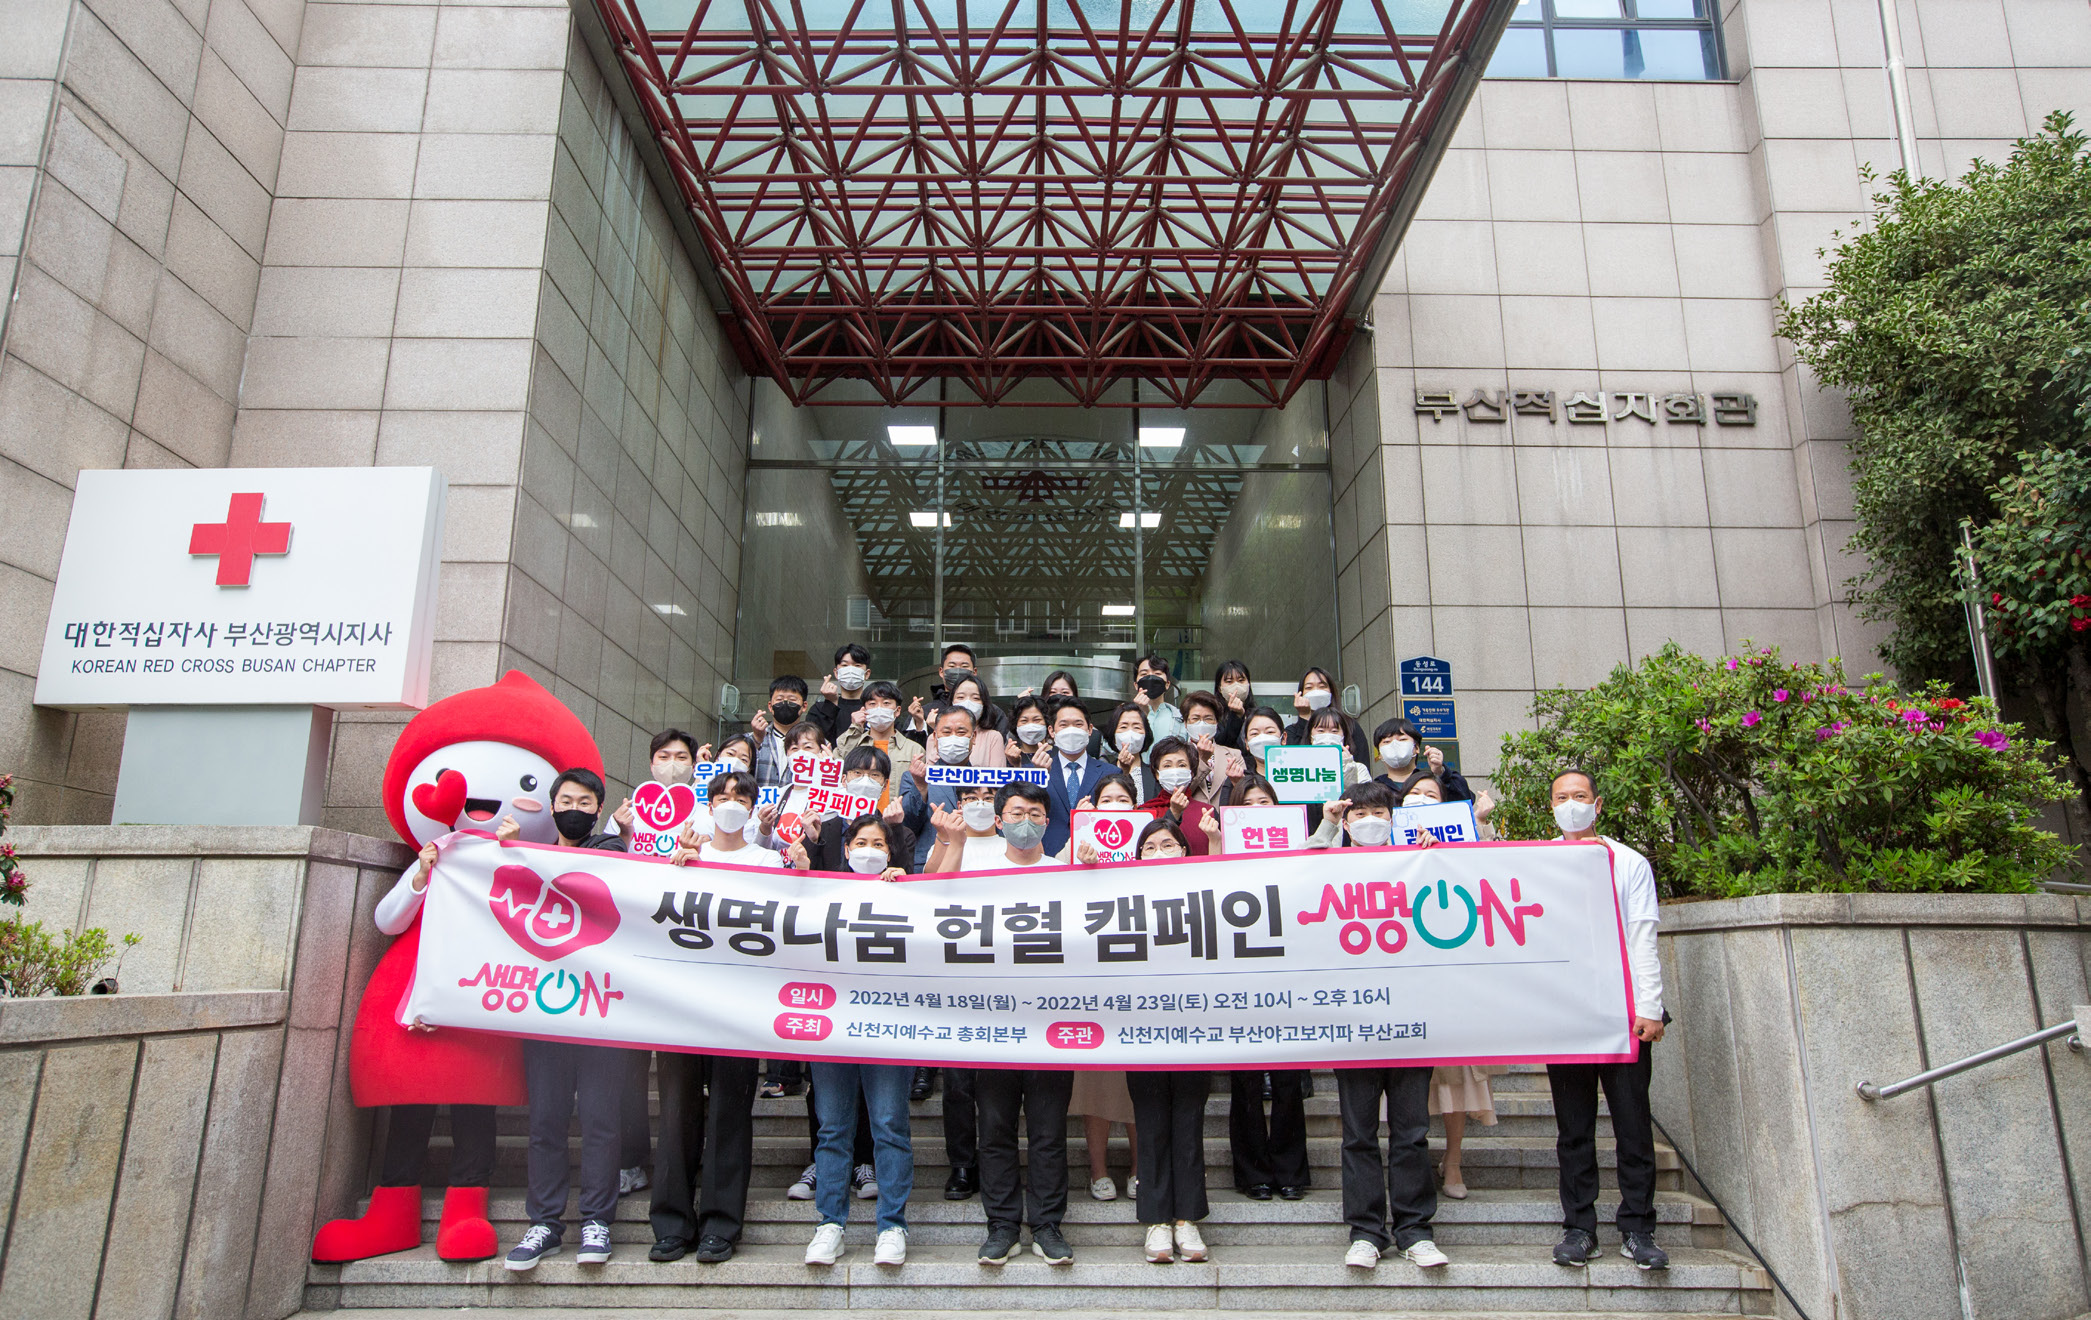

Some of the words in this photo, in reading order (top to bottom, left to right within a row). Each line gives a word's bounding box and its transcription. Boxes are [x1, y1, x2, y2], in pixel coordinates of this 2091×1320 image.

[64, 621, 217, 648] 대한적십자사
[224, 621, 392, 647] 부산광역시지사
[71, 659, 137, 673] KOREAN
[143, 659, 174, 673] RED
[181, 659, 235, 674] CROSS
[242, 659, 296, 673] BUSAN
[302, 658, 377, 673] CHAPTER
[1411, 676, 1444, 692] 144
[793, 756, 842, 788] 헌혈
[927, 767, 1047, 786] 부산야고보지파
[1272, 767, 1337, 783] 생명나눔
[808, 787, 876, 818] 캠페인
[1241, 827, 1290, 849] 헌혈
[651, 891, 914, 963] 생명나눔
[934, 901, 1065, 964] 헌혈
[1084, 884, 1285, 963] 캠페인
[789, 987, 825, 1007] 일시
[849, 988, 911, 1007] 2022년
[914, 991, 943, 1009] 4월
[947, 993, 1017, 1012] 18일(월)
[1036, 993, 1099, 1012] 2022년
[1103, 993, 1133, 1012] 4월
[1136, 993, 1209, 1013] 23일(토)
[1212, 991, 1249, 1010] 오전
[1253, 990, 1293, 1009] 10시
[1312, 988, 1348, 1007] 오후
[1352, 986, 1391, 1006] 16시
[785, 1017, 822, 1037] 주최
[846, 1021, 953, 1042] 신천지예수교
[956, 1025, 1028, 1044] 총회본부
[1057, 1026, 1094, 1046] 주관
[1117, 1025, 1225, 1045] 신천지예수교
[1228, 1024, 1354, 1045] 부산야고보지파
[1357, 1021, 1428, 1041] 부산교회
